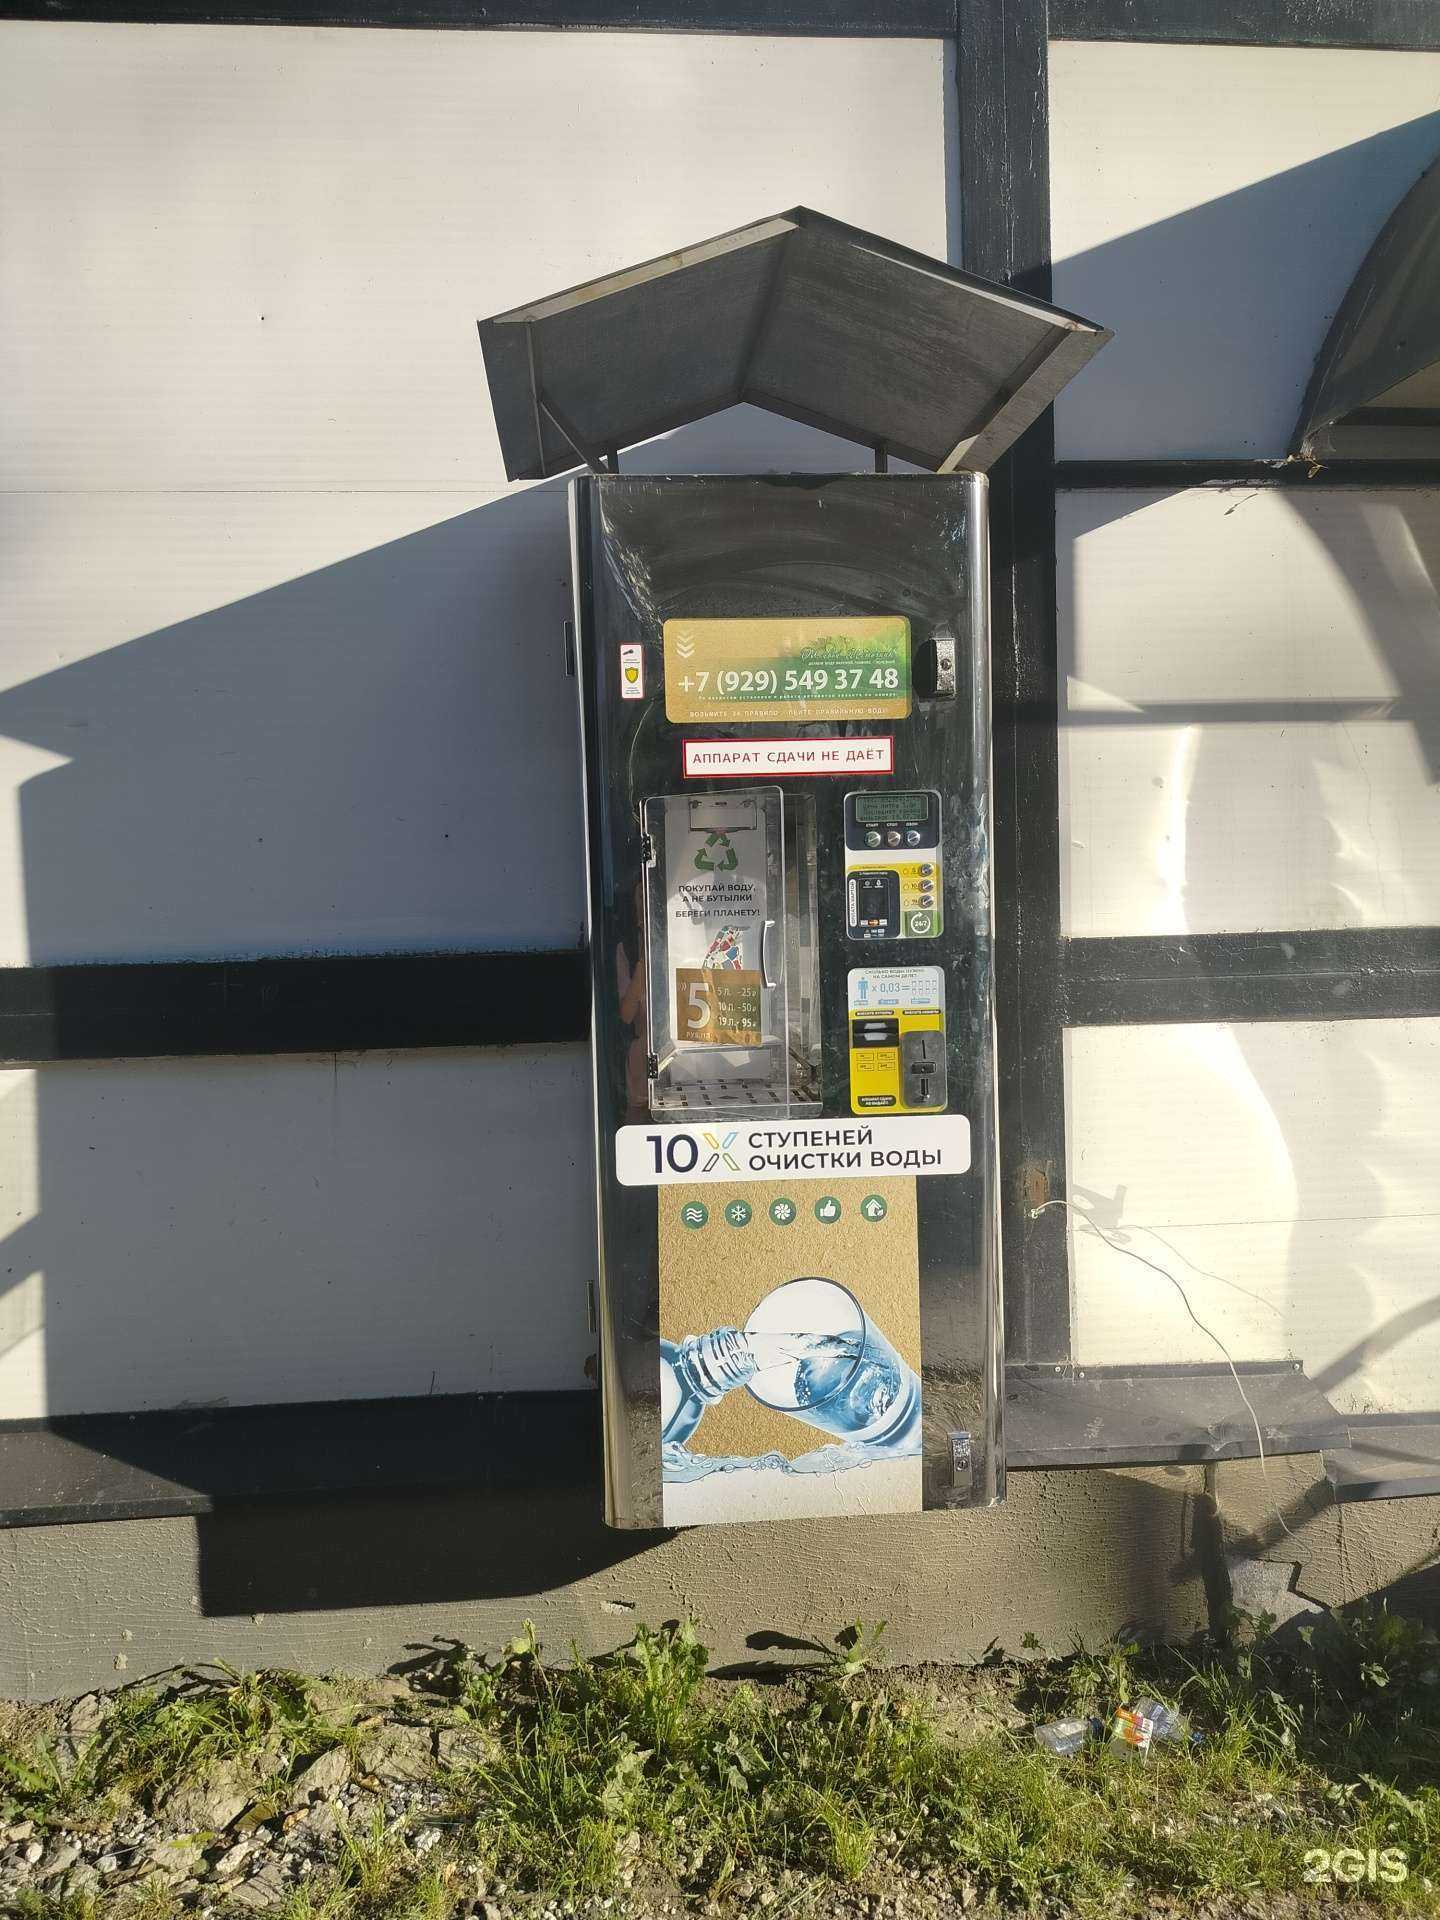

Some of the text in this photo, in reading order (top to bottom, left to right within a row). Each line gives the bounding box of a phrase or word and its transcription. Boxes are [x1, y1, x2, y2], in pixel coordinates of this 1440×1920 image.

[678, 668, 899, 694] +7 (929) 549 37 48
[693, 746, 885, 766] АППАРАТ СДАЧИ НЕ ДАЁТ
[678, 882, 725, 892] ПОКУПАЙ
[706, 894, 752, 902] БУТЫЛКИ
[676, 909, 760, 918] БЕРЕГИ ПЛАНЕТУ!
[880, 982, 900, 994] 0,03
[688, 982, 710, 1029] 5
[718, 1002, 726, 1011] 10
[719, 1017, 727, 1026] 19
[742, 1018, 752, 1027] 95
[748, 1125, 873, 1149] СТУПЕНЕЙ
[750, 1149, 942, 1172] ОЧИСТКИ ВОДЫ
